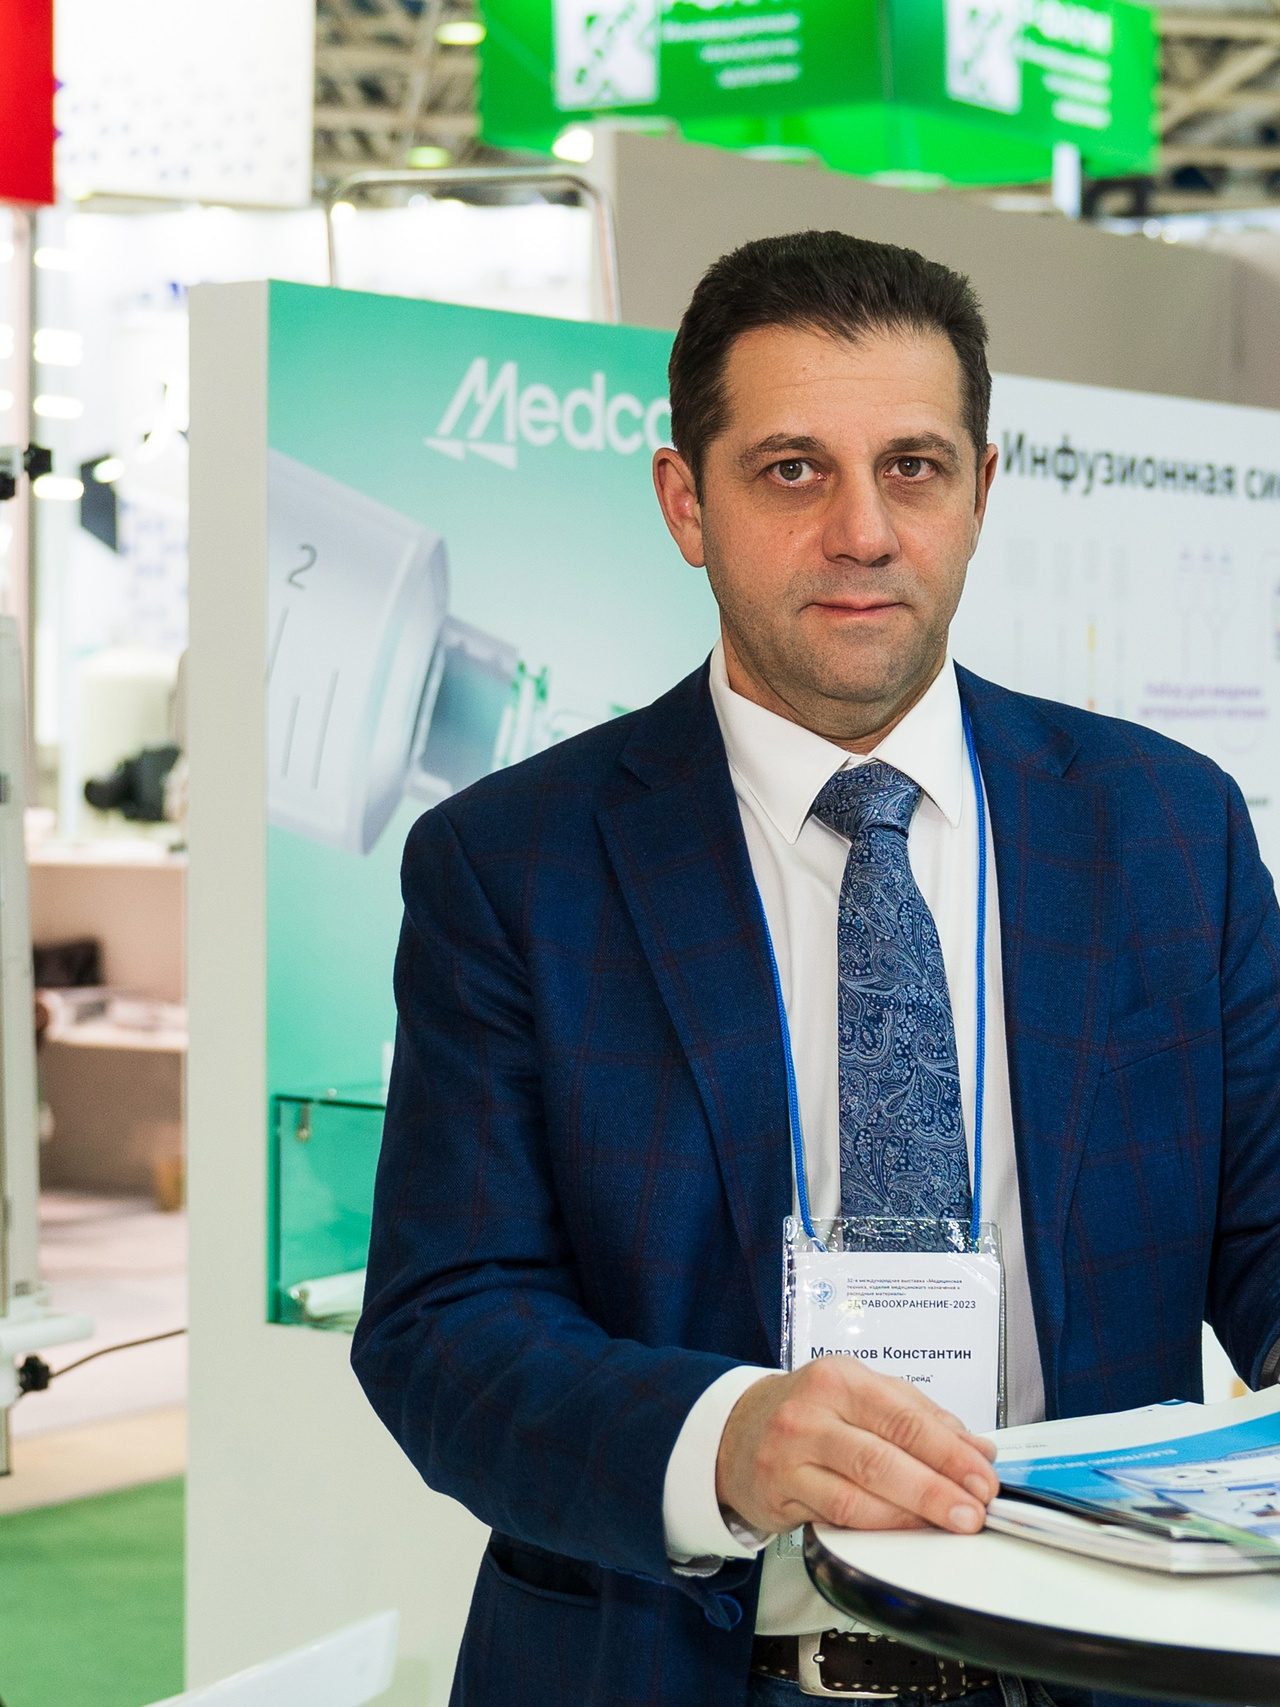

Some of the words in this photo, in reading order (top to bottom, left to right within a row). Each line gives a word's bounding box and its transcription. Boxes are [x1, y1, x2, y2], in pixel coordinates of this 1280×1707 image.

[1002, 431, 1236, 495] Инфузионная
[287, 543, 317, 591] 2
[883, 1346, 972, 1359] Константин
